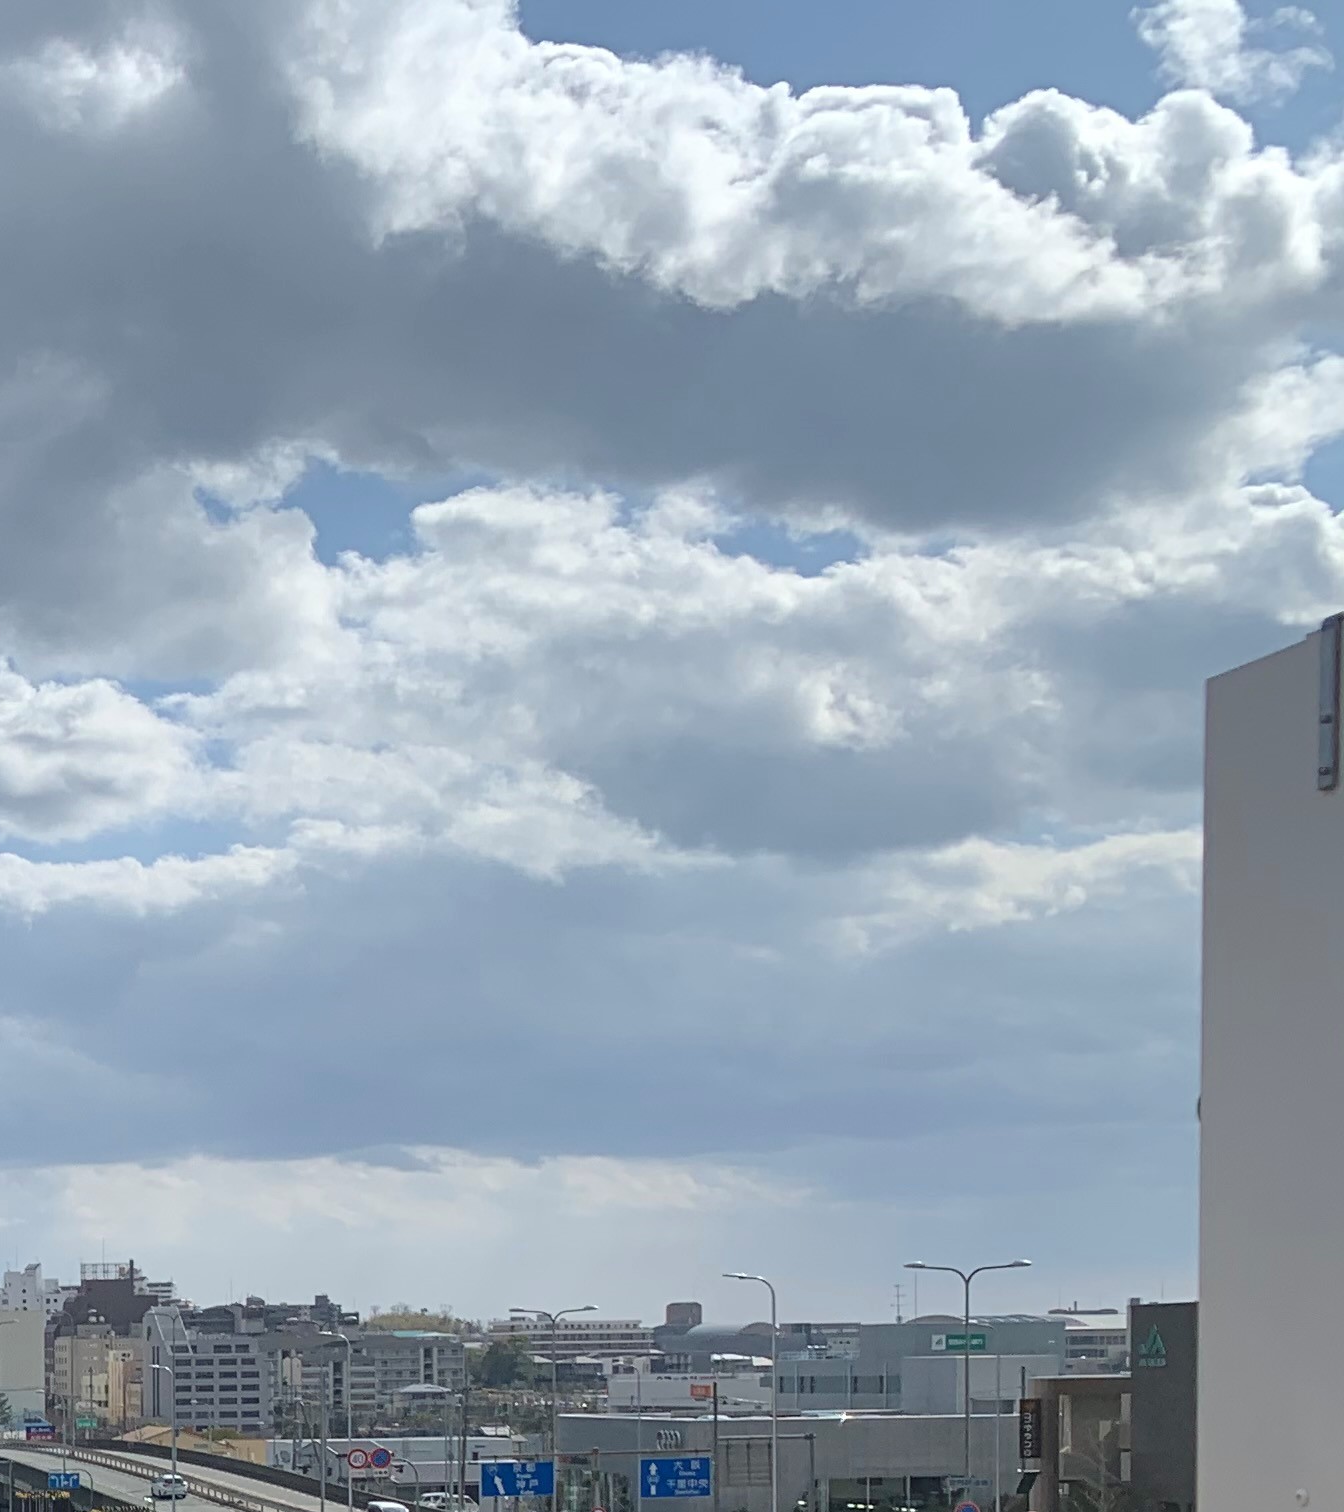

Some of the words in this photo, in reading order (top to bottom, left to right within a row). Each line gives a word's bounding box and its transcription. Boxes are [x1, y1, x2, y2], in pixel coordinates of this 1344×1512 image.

[516, 1479, 539, 1490] 神戸
[666, 1478, 709, 1489] 千里中央
